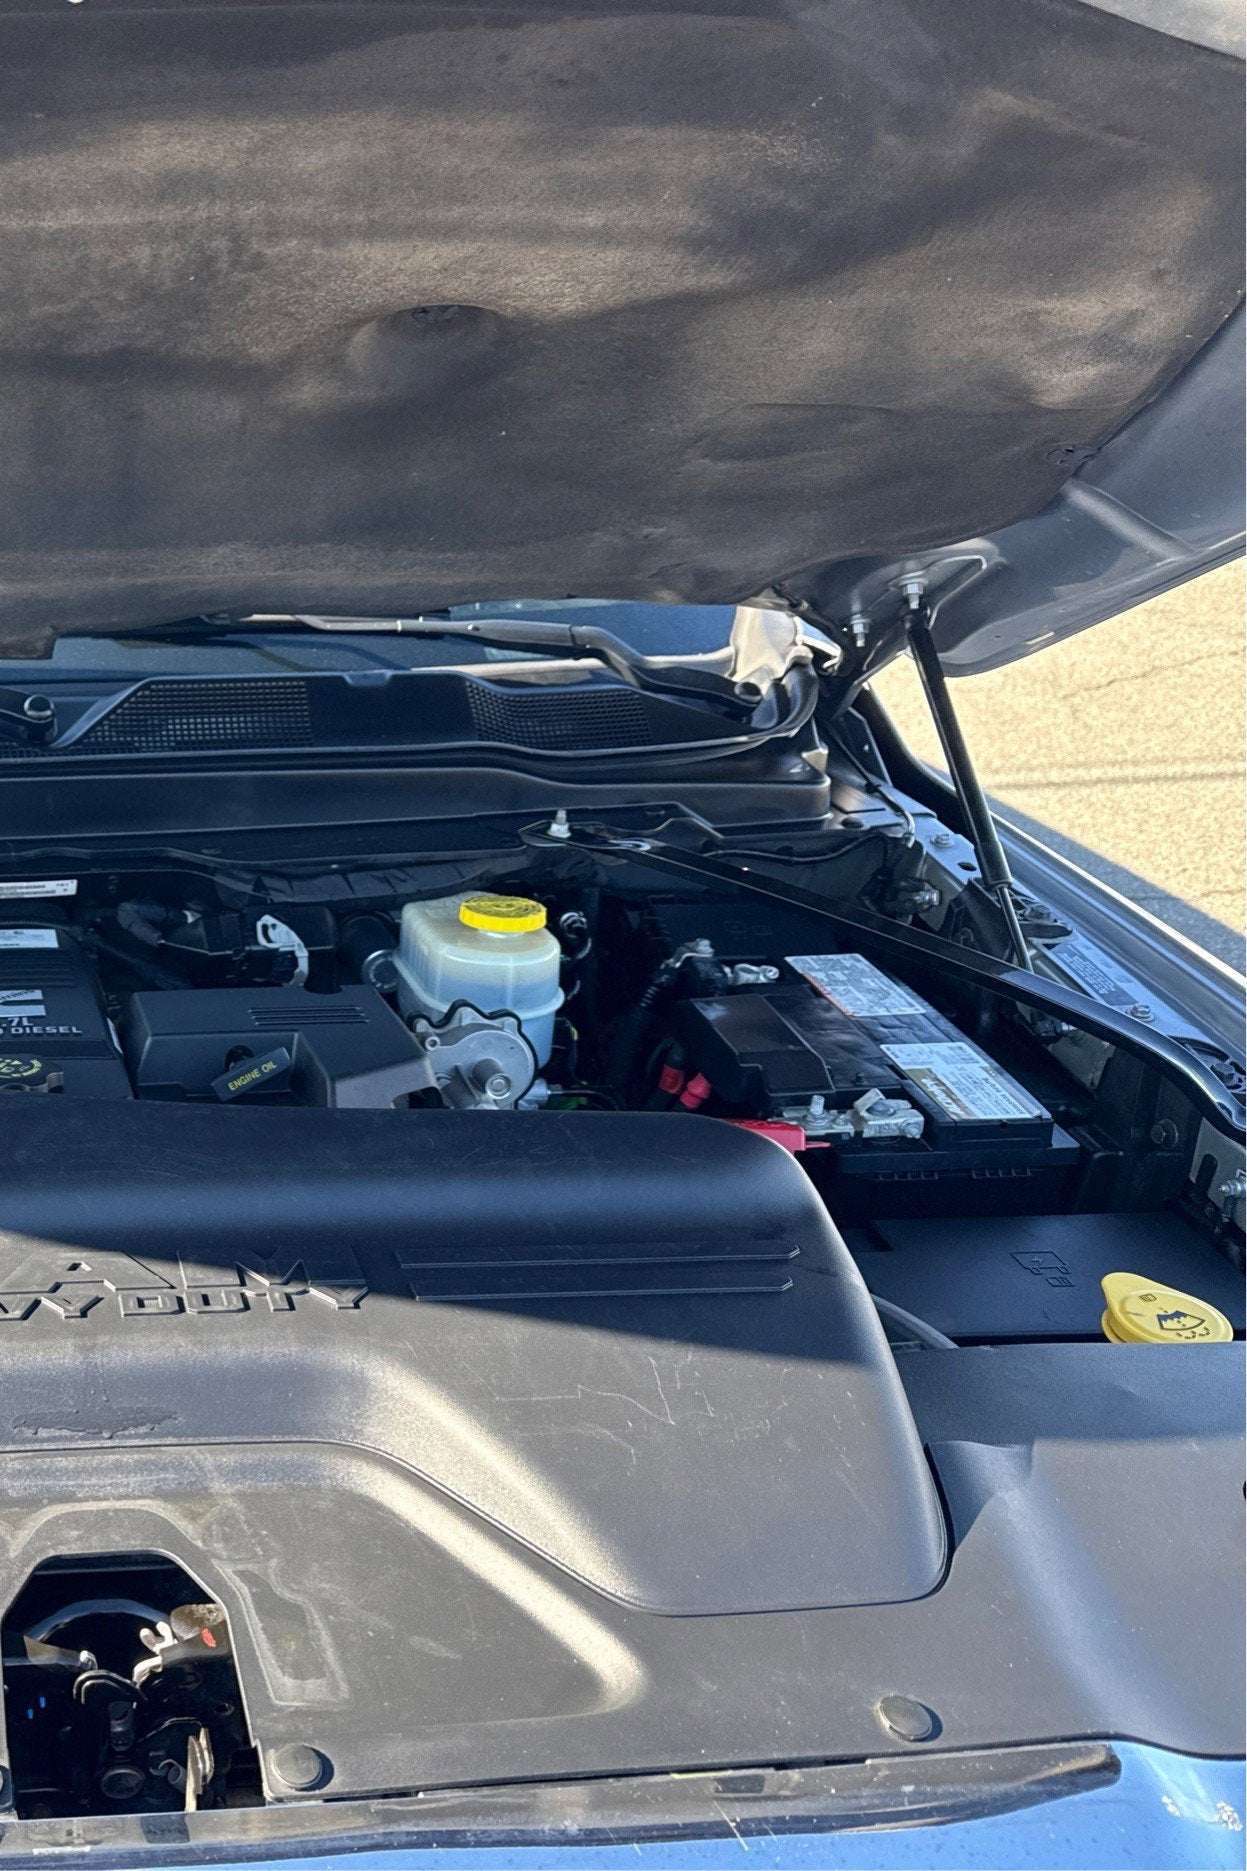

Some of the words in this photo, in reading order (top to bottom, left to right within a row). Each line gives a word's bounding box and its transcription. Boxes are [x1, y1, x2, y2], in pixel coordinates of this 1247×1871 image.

[11, 1025, 83, 1035] DIESEL
[227, 1068, 262, 1091] ENGINE
[261, 1061, 277, 1073] OIL
[117, 1285, 370, 1318] DUTY
